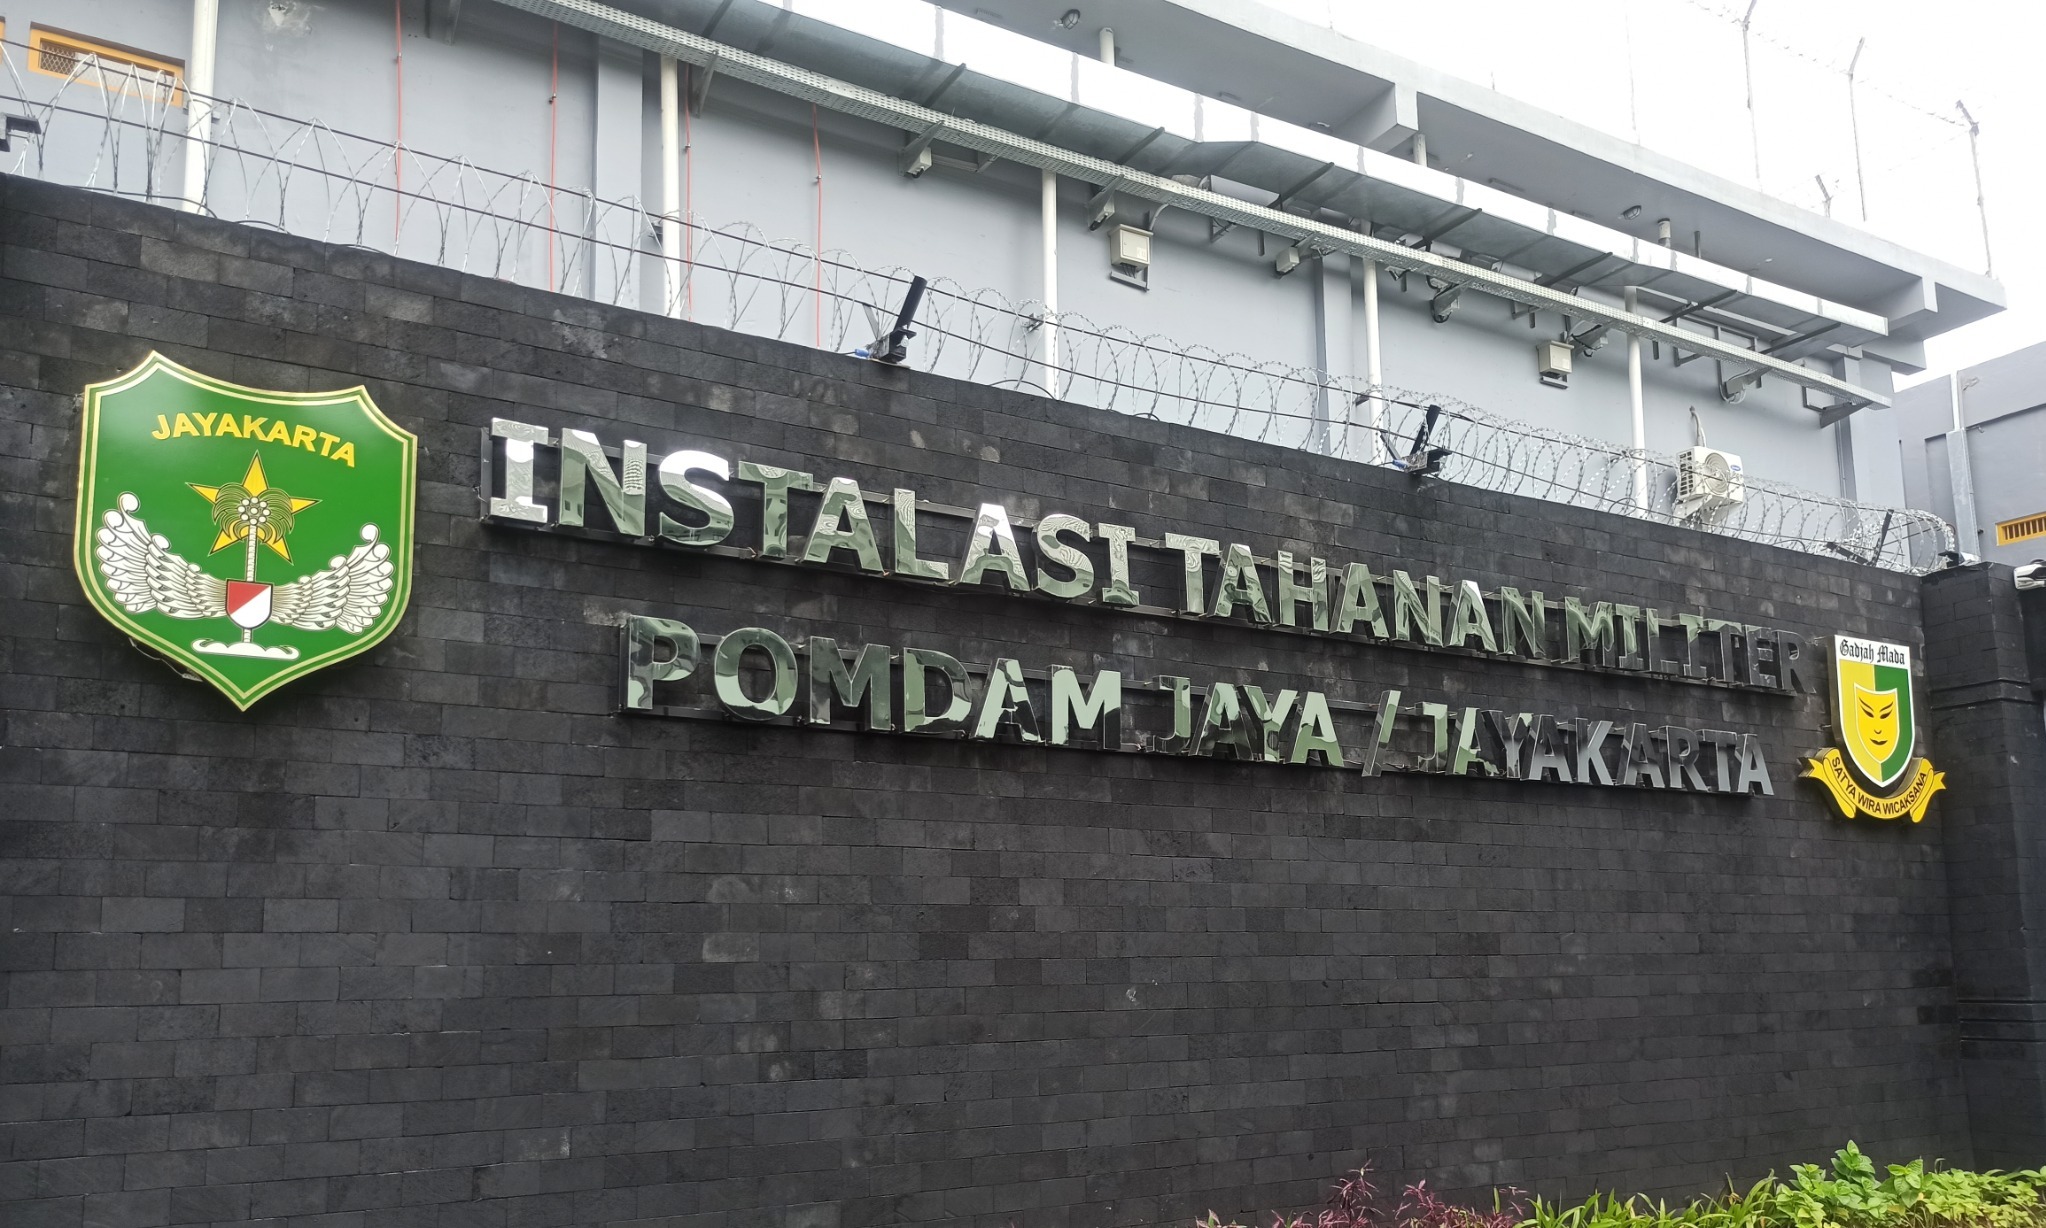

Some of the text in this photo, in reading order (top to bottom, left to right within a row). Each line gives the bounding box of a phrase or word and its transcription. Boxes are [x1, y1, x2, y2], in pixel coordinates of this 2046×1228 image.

[152, 412, 355, 467] JAYAKARTA
[489, 417, 1816, 694] INSTALASI TAHANAN MILITER
[1840, 639, 1905, 665] Gadjah Mada
[627, 614, 1122, 749] POMDAM
[1153, 675, 1344, 767] JAYA
[1417, 702, 1774, 796] JAYAKARTA
[1832, 756, 1927, 815] SATYA WIRA WICAKSANA
